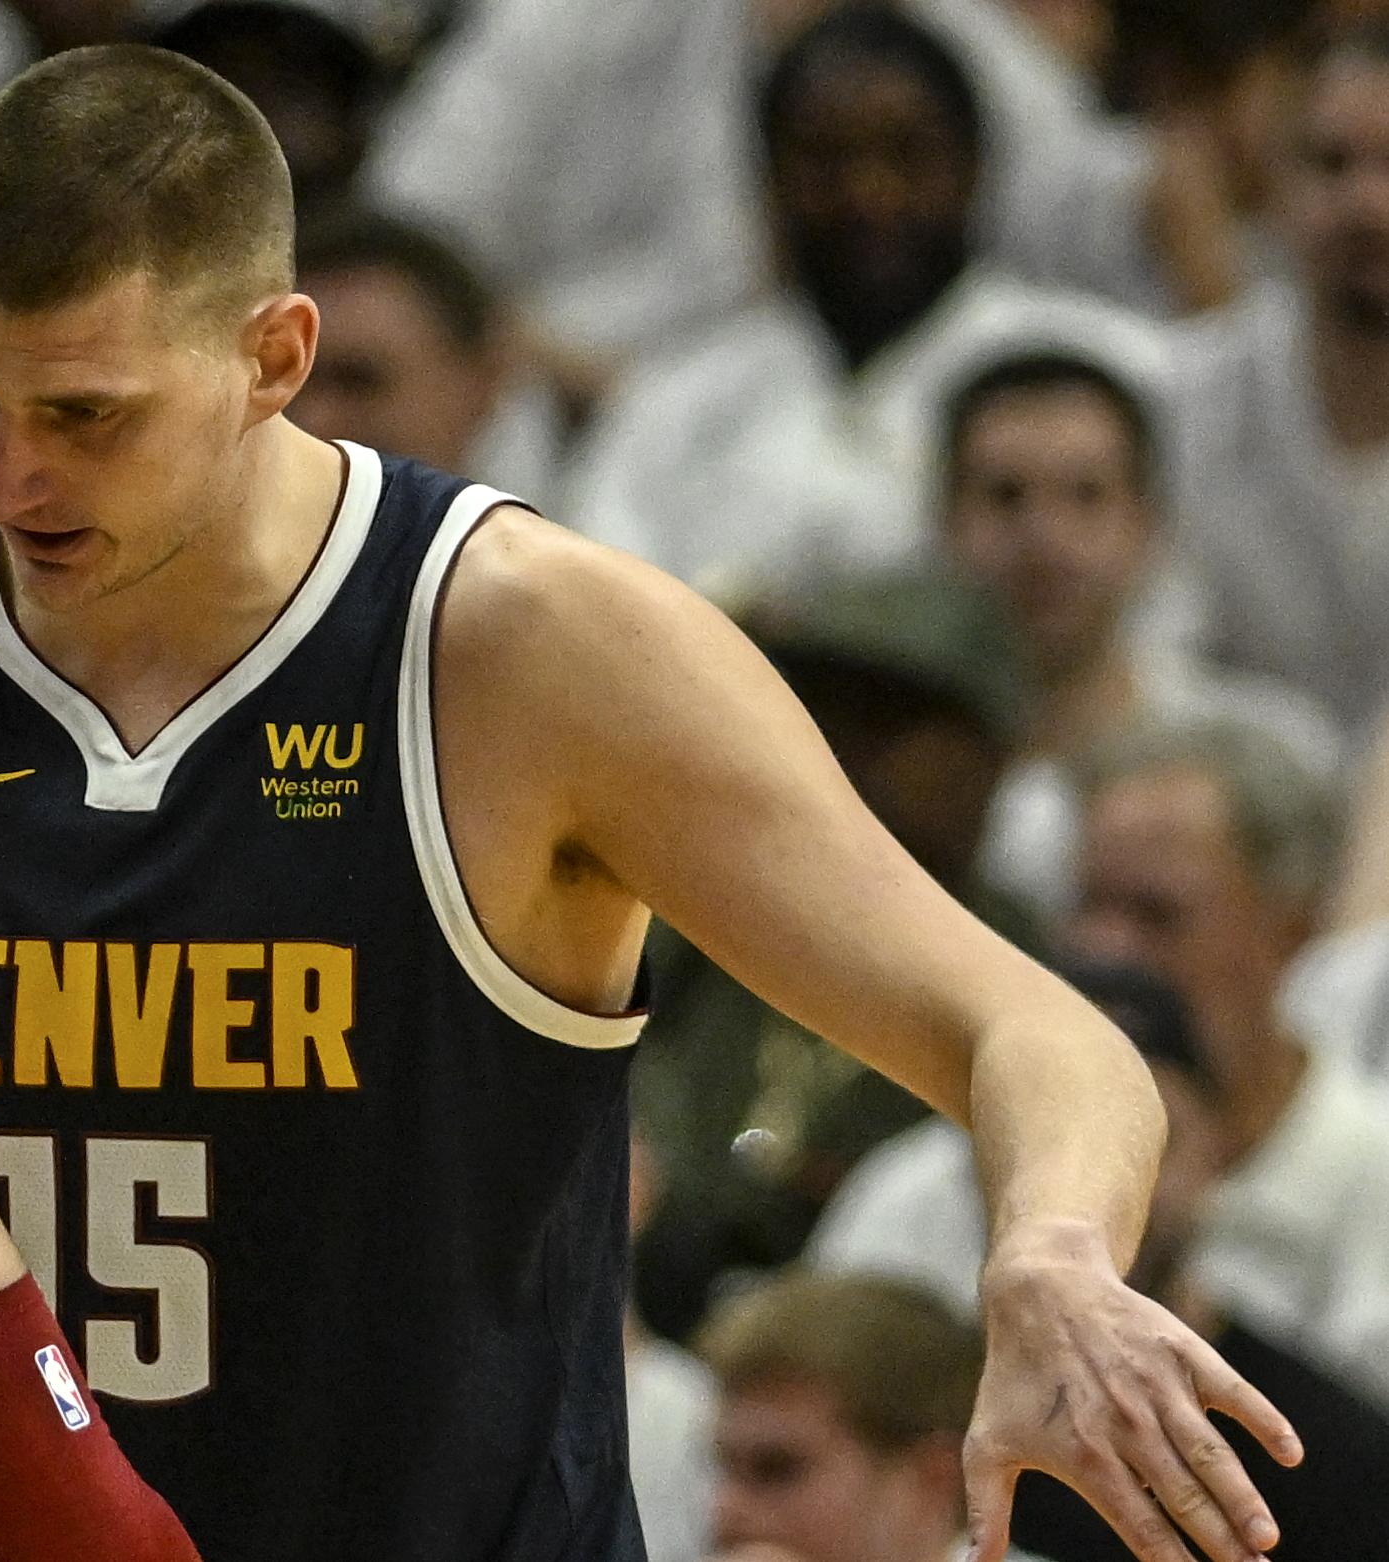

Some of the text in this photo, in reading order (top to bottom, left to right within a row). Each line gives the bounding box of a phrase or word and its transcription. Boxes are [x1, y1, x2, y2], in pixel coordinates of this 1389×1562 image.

[265, 722, 364, 770] WU
[260, 777, 359, 797] Western
[276, 797, 342, 819] Union
